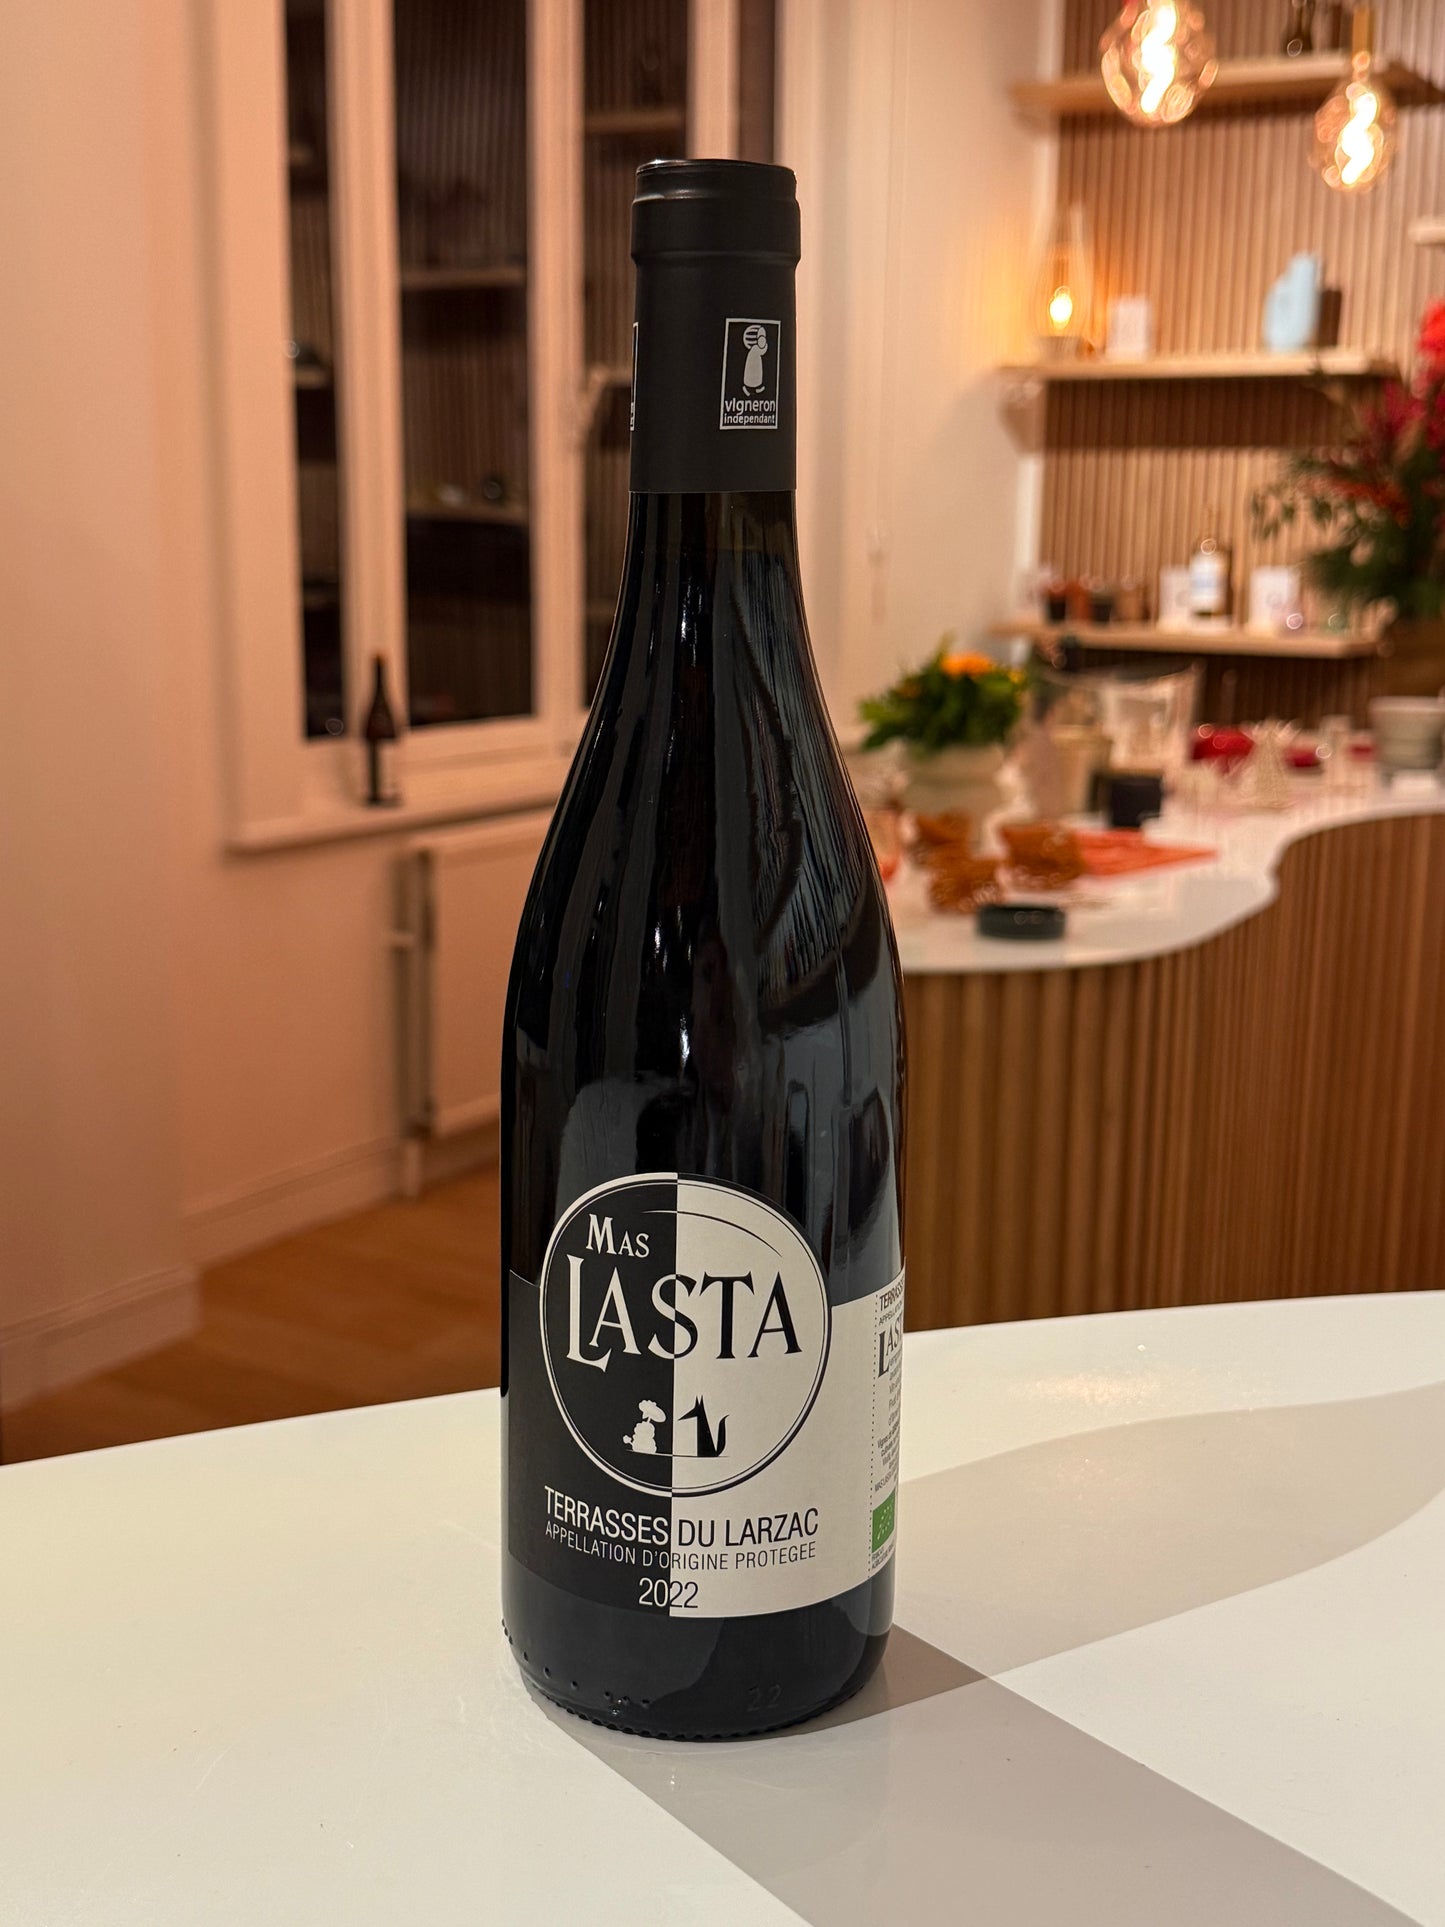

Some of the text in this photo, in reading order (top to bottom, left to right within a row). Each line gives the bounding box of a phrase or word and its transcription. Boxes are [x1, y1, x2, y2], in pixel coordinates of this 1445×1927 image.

[724, 398, 776, 416] vigneron
[724, 413, 775, 425] independant
[586, 1213, 650, 1258] MAS
[566, 1254, 802, 1372] LASTA
[878, 1312, 902, 1378] LAST
[544, 1485, 819, 1547] TERRASSES DU LARZAC
[545, 1521, 816, 1571] APPELLATION D'ORIGINE PROTEGEE
[638, 1577, 699, 1609] 2022
